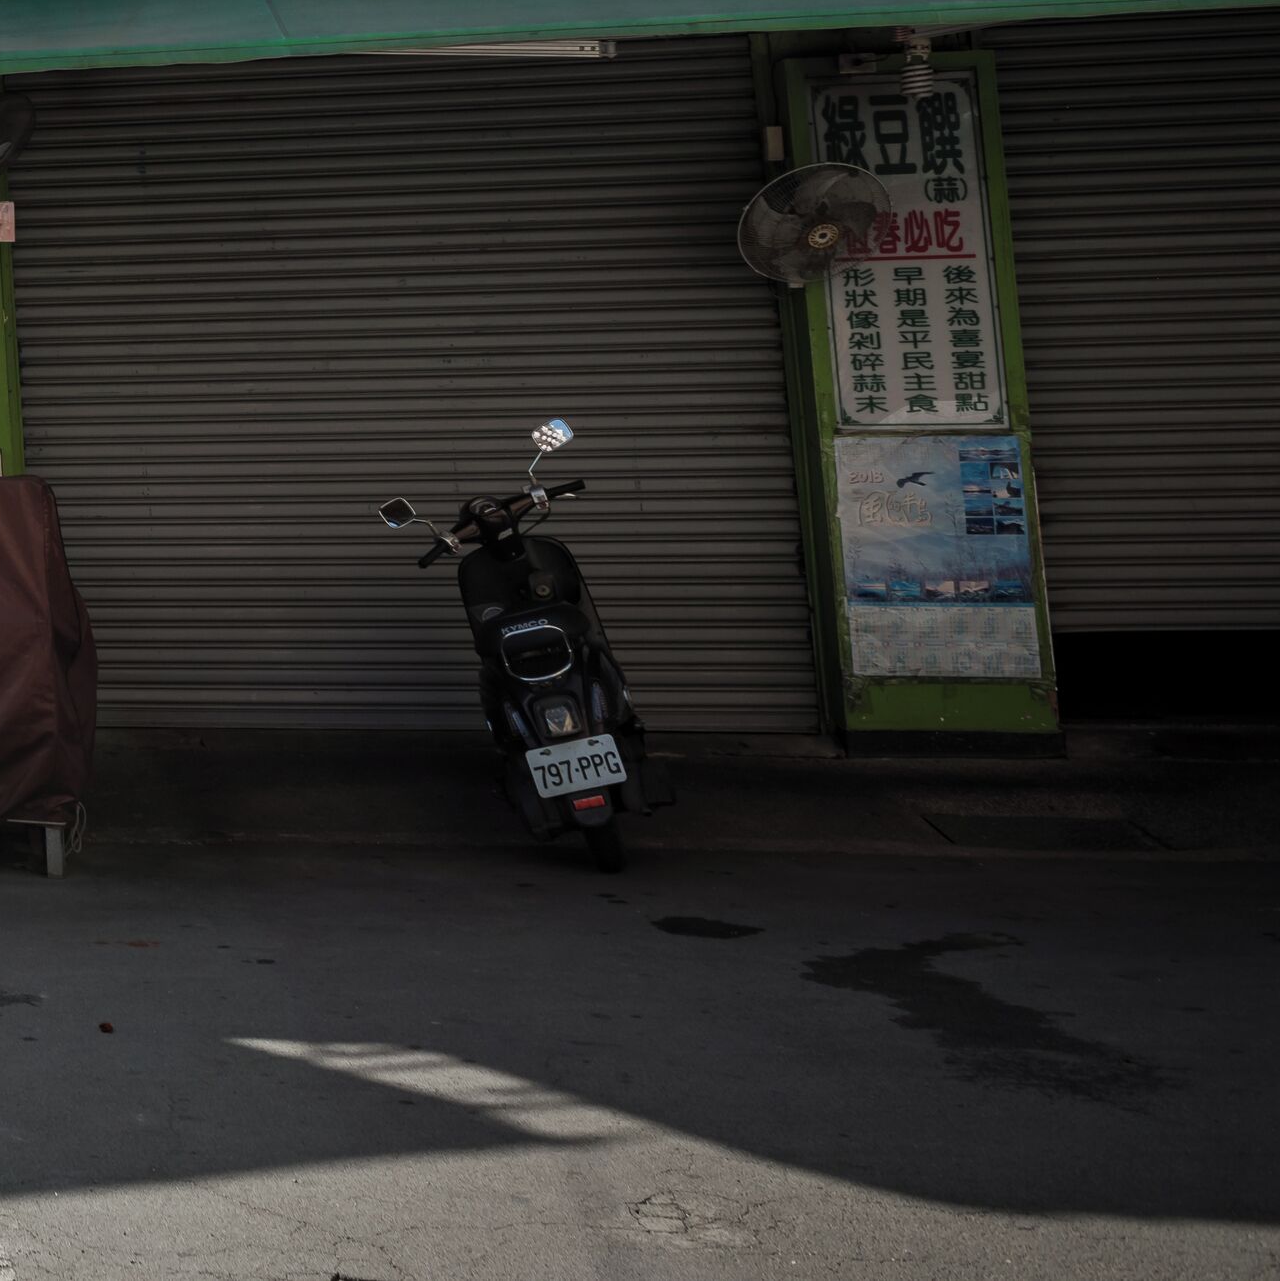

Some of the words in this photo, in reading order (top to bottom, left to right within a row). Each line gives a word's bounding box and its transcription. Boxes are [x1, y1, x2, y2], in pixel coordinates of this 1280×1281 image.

[924, 176, 968, 203] (蒜)
[841, 267, 890, 415] 形狀像剁碎蒜末
[891, 267, 938, 415] 早期是平民主食
[941, 265, 990, 414] 後來為喜宴甜點
[501, 618, 549, 636] KYMCO
[533, 748, 623, 792] 797-PPG
